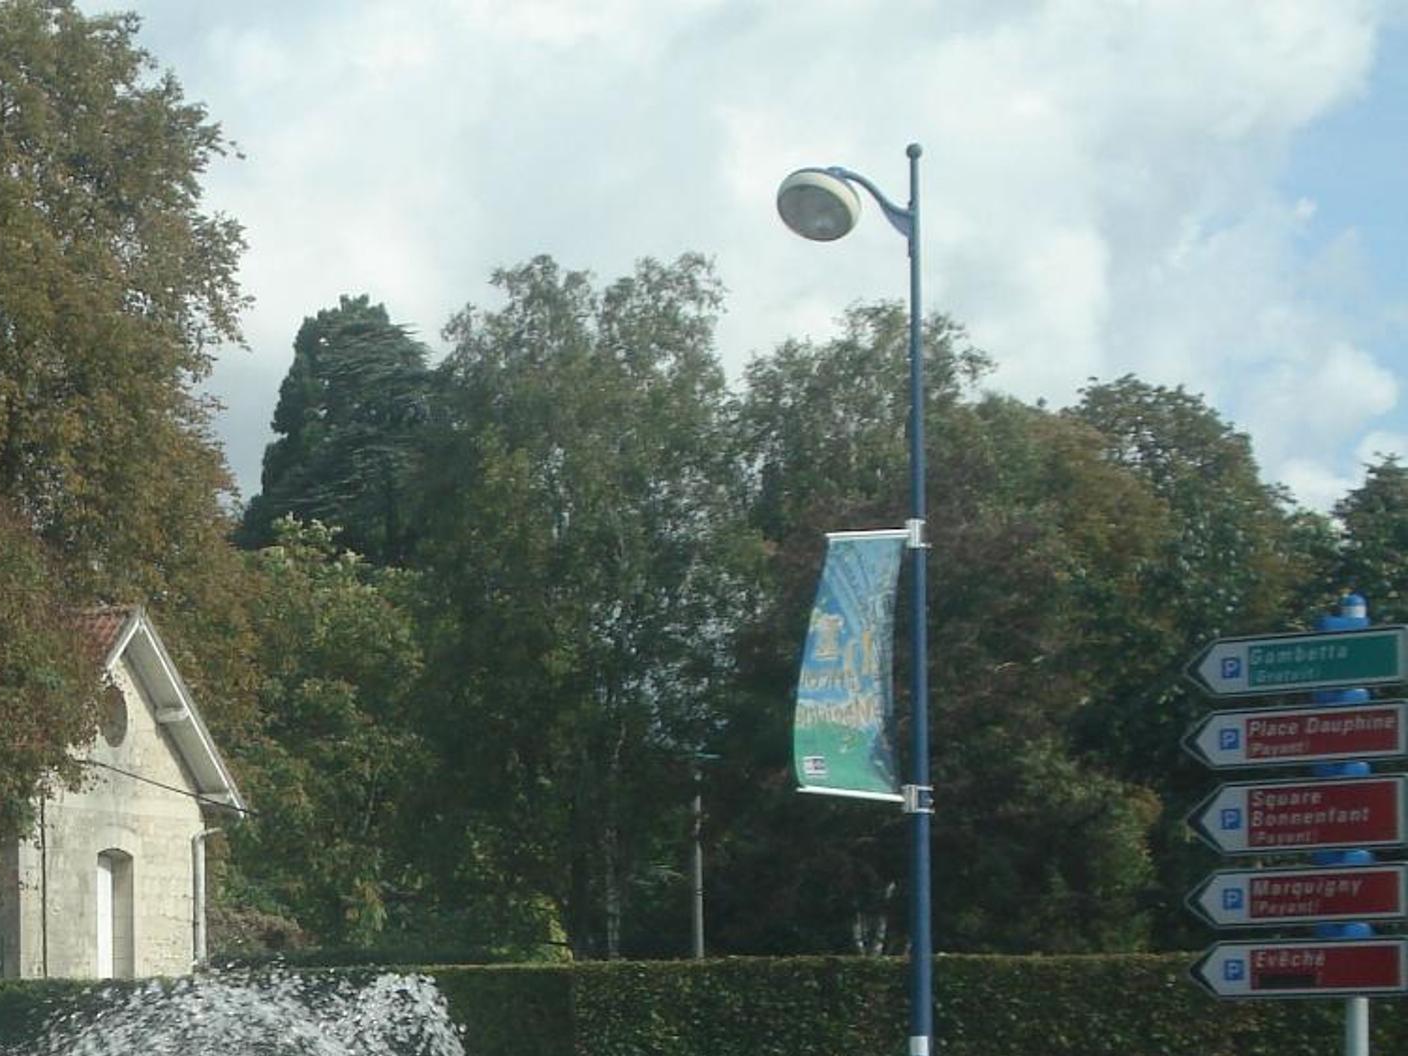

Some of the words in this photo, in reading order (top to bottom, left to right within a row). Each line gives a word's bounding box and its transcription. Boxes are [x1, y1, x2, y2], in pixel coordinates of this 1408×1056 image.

[1249, 645, 1348, 665] Gambetta
[1249, 719, 1299, 737] Place
[1305, 715, 1397, 737] Dauphine
[1252, 790, 1323, 810] Square
[1252, 807, 1370, 828] Bonnenfant
[1253, 878, 1363, 898] Marquigny
